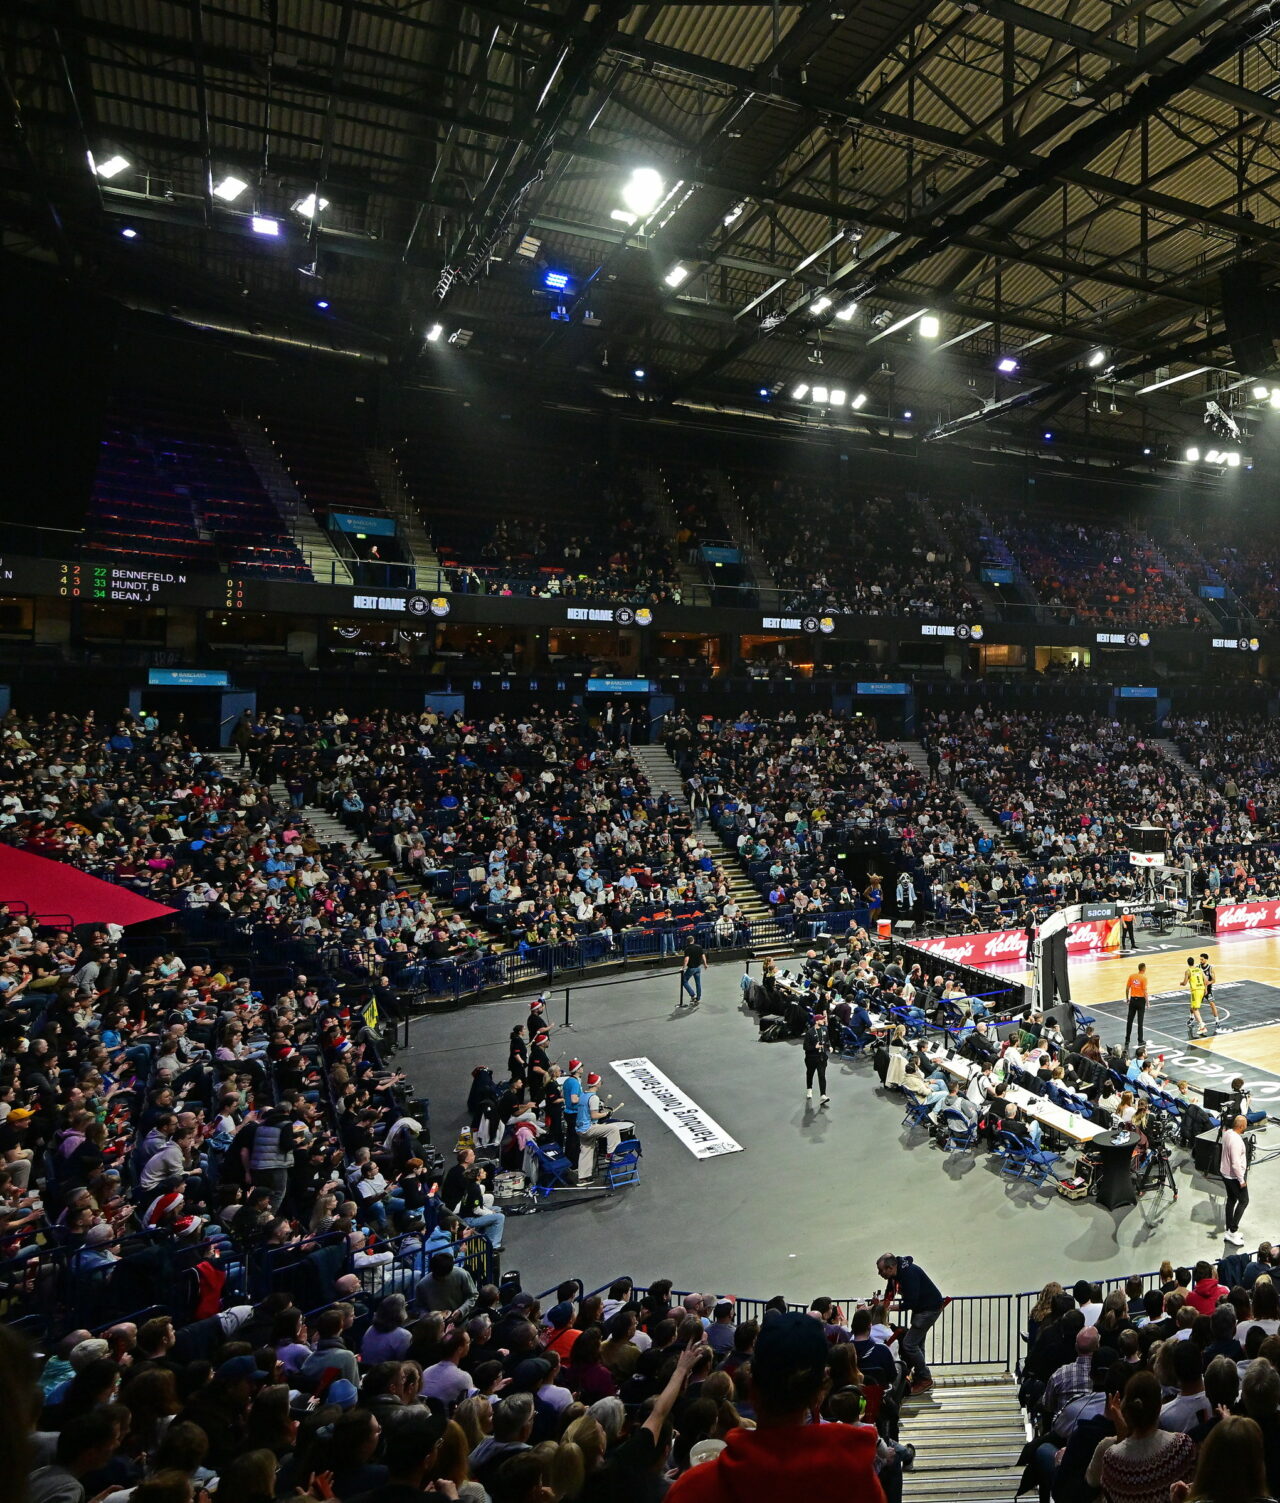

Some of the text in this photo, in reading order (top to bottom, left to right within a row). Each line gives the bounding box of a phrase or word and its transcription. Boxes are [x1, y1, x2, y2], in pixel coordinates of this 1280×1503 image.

[5, 570, 12, 579] N
[61, 565, 80, 574] 3 2
[61, 576, 80, 585] 4 3
[94, 568, 186, 584] 22 BENNEFELD, N
[94, 579, 159, 592] 33 HUNDT, B
[60, 587, 80, 596] 0 0
[94, 590, 151, 602] 34 BEAN, J
[354, 596, 378, 609] NEXT
[378, 597, 406, 611] GAME
[567, 608, 613, 621] NEXT GAME
[763, 617, 801, 630] NEXT GAME
[922, 625, 955, 636] NEXT GAME
[1097, 633, 1125, 644] NEXT GAME
[1212, 638, 1237, 648] NEXT GAME
[1130, 904, 1156, 914] Schindler
[1219, 906, 1268, 927] Kellogg's
[626, 1068, 719, 1144] Hamburg Towers Fanclub
